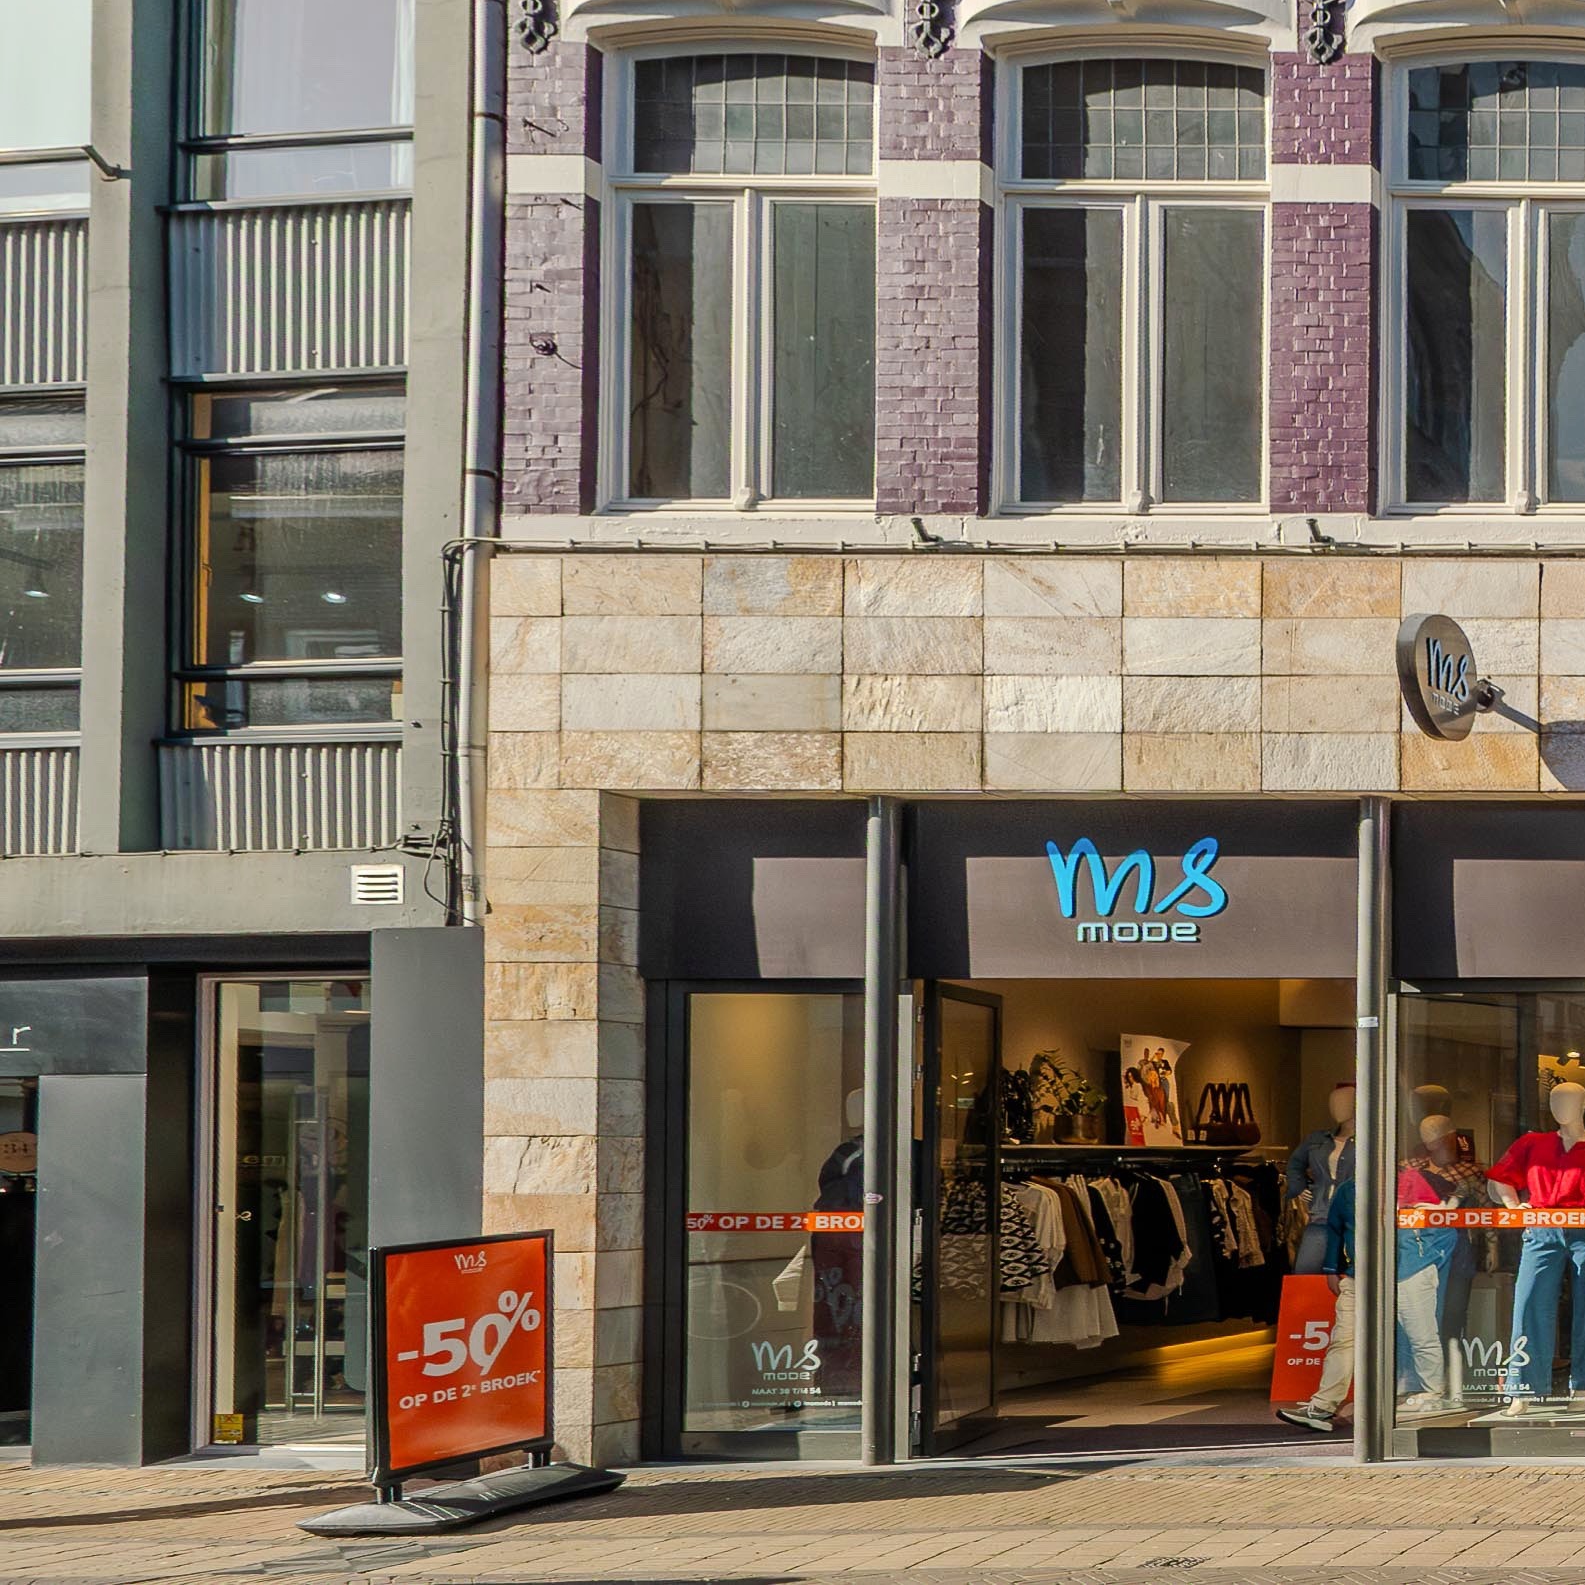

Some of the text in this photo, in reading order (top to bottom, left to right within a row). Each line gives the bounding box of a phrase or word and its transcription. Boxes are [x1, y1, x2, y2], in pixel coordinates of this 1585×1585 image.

[718, 1216, 749, 1229] OP
[755, 1216, 784, 1229] DE
[815, 1216, 864, 1229] BRO
[1429, 1212, 1459, 1225] OP
[1465, 1212, 1493, 1225] DE
[397, 1290, 541, 1377] -50%
[1289, 1321, 1331, 1351] -5
[399, 1393, 428, 1410] OP
[433, 1387, 457, 1404] DE
